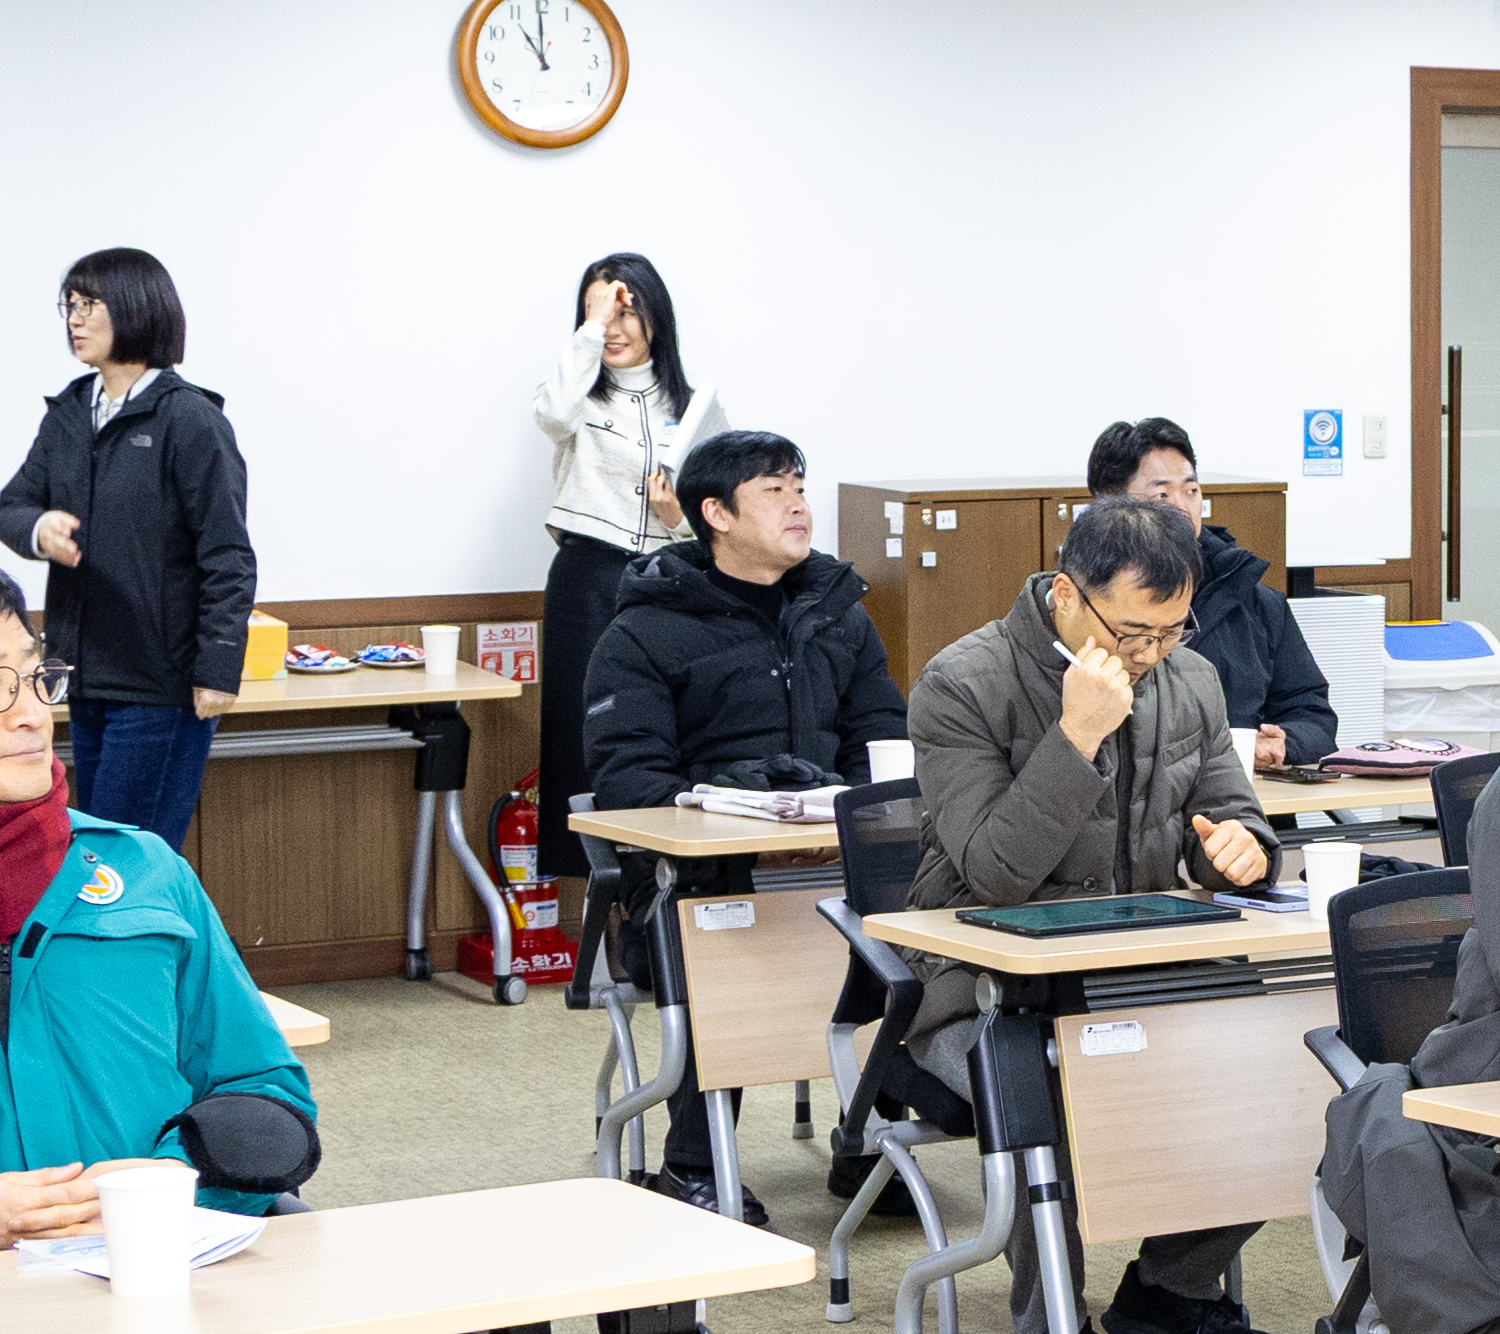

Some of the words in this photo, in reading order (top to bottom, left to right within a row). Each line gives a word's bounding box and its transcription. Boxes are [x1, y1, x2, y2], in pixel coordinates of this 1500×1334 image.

[510, 4, 521, 20] 11
[489, 25, 505, 41] 10
[581, 27, 591, 42] 2
[484, 51, 495, 65] 9
[588, 54, 599, 70] 3
[491, 77, 503, 93] 8
[580, 82, 591, 96] 4
[482, 627, 533, 642] 소화기
[510, 952, 572, 969] 소화기
